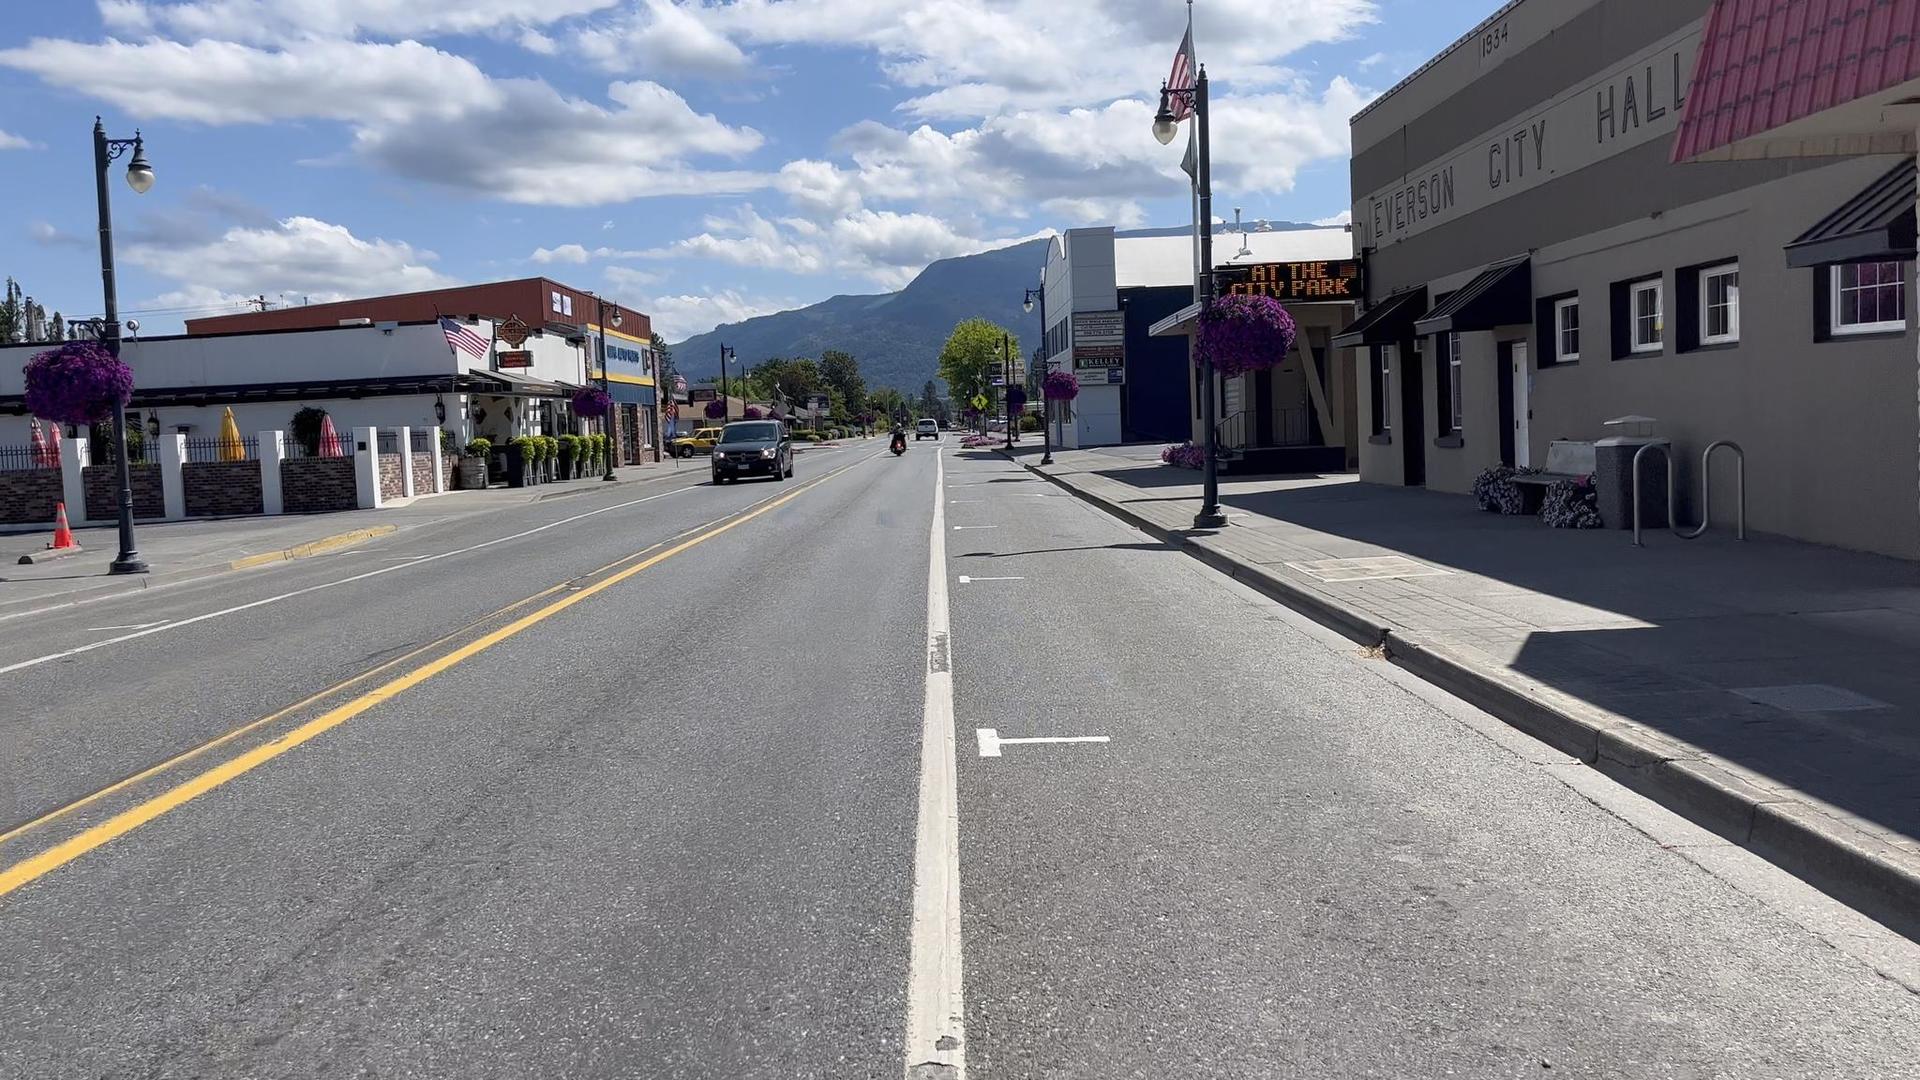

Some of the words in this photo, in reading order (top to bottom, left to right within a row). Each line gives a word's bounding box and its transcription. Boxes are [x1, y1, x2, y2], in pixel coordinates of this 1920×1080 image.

[1482, 22, 1508, 58] 1934
[1374, 165, 1455, 238] EVERSON
[1488, 119, 1546, 189] CITY
[1597, 52, 1686, 144] HALL
[1251, 265, 1280, 281] AT
[1287, 262, 1328, 279] THE
[1231, 281, 1285, 297] CITY
[1291, 278, 1350, 296] PARK
